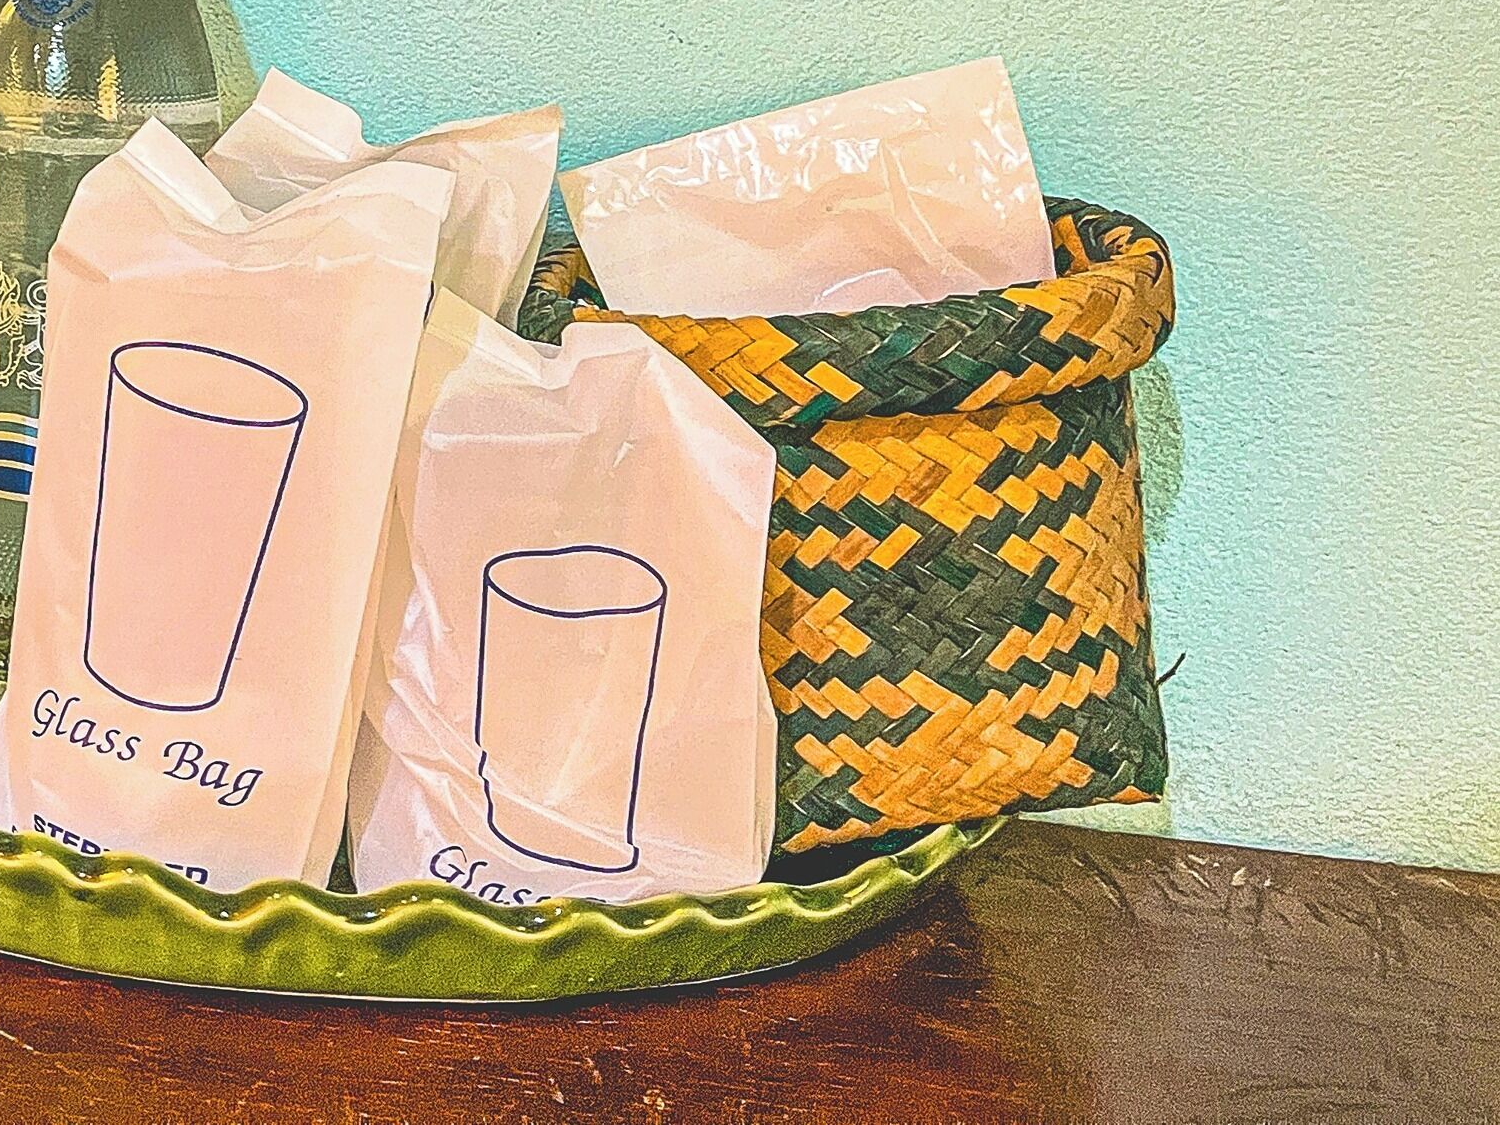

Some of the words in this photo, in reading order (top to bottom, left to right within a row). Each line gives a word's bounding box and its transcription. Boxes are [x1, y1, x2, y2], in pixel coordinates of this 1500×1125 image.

[32, 690, 141, 760] Glass
[163, 742, 264, 806] Bag
[430, 846, 551, 905] Glas
